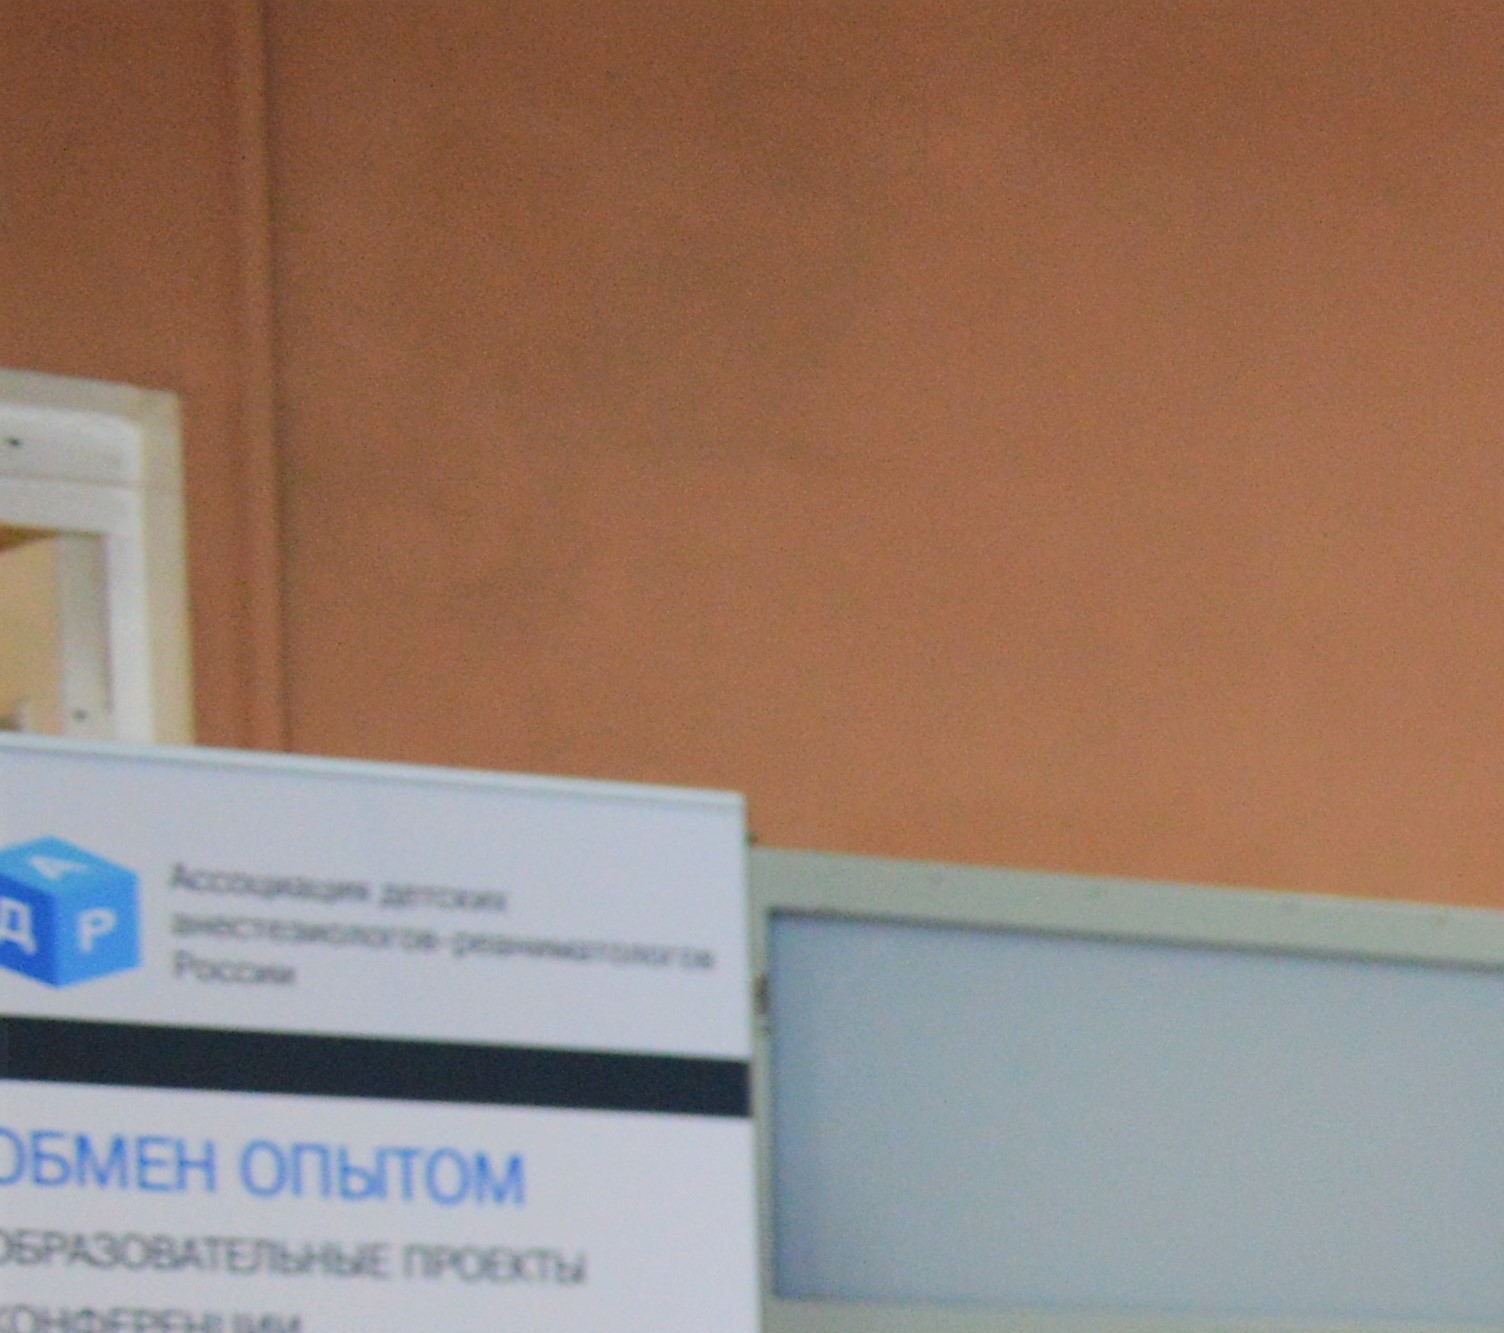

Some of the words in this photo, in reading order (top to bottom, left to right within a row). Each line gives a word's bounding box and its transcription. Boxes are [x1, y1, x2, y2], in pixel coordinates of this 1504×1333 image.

[169, 862, 370, 903] Ассоциация
[380, 881, 508, 913] детских
[172, 948, 297, 984] России
[239, 1138, 528, 1207] ОПЫТОМ
[402, 1244, 591, 1286] ПРОЕКТЫ
